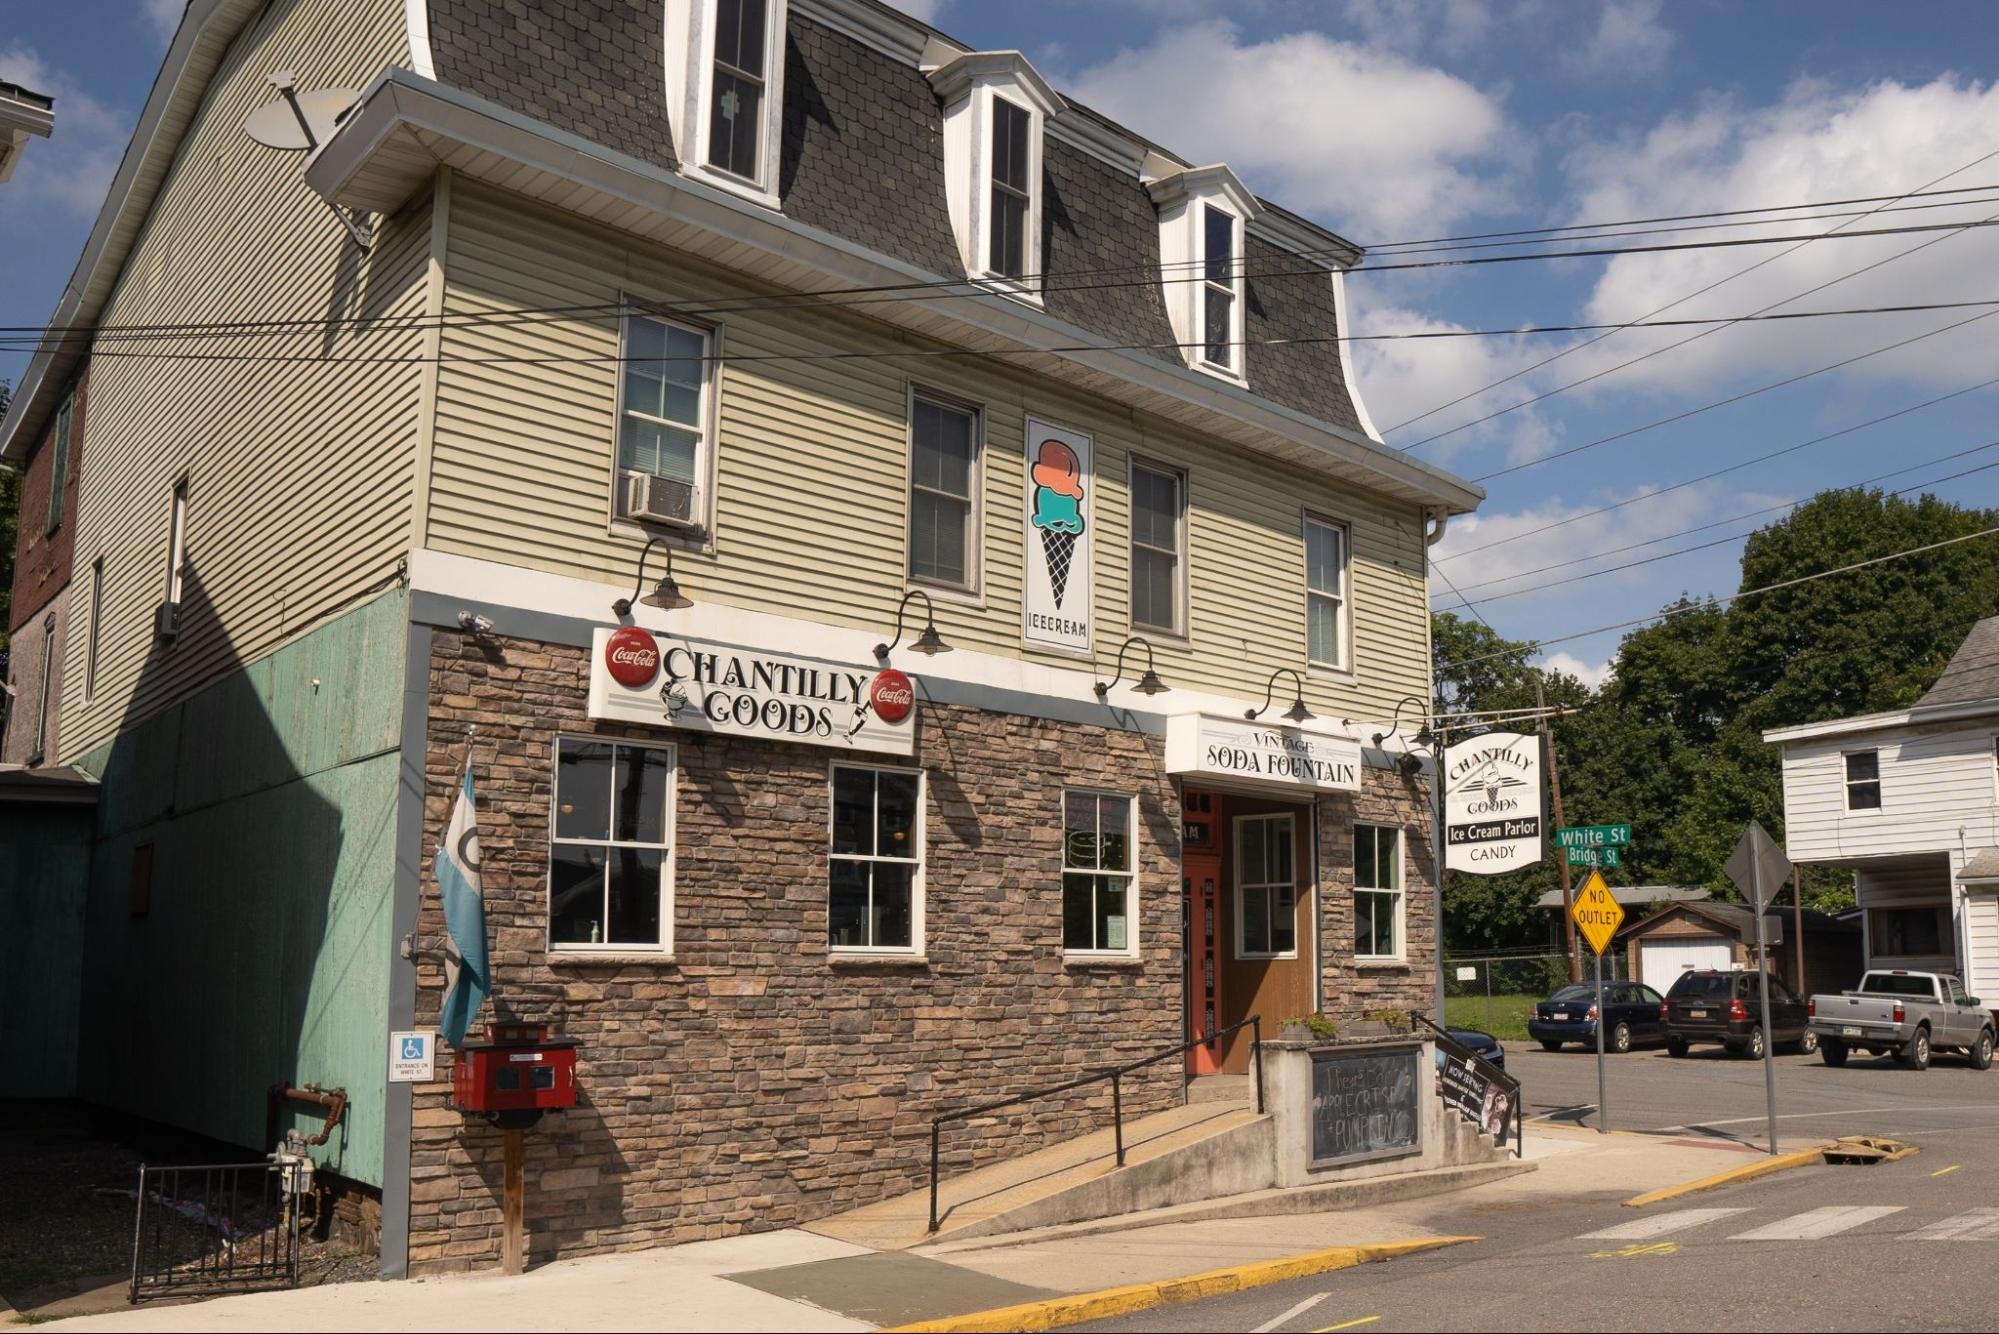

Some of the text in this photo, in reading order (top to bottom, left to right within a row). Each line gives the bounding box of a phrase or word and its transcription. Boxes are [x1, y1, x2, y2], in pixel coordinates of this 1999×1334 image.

[663, 647, 868, 704] CHANTILLY
[704, 690, 834, 738] GOODS
[1253, 732, 1314, 754] VINTAGE
[1207, 744, 1355, 784] SODA FOUNTAIN
[1450, 747, 1534, 782] CHANTILLY
[1467, 799, 1518, 815] GOODS
[1451, 821, 1536, 841] Ice Cream Parlor
[1561, 827, 1625, 845] White St
[1470, 845, 1516, 861] CANDY
[1569, 847, 1617, 864] Bridge St
[1589, 890, 1605, 904] NO
[1579, 910, 1617, 925] OUTLET
